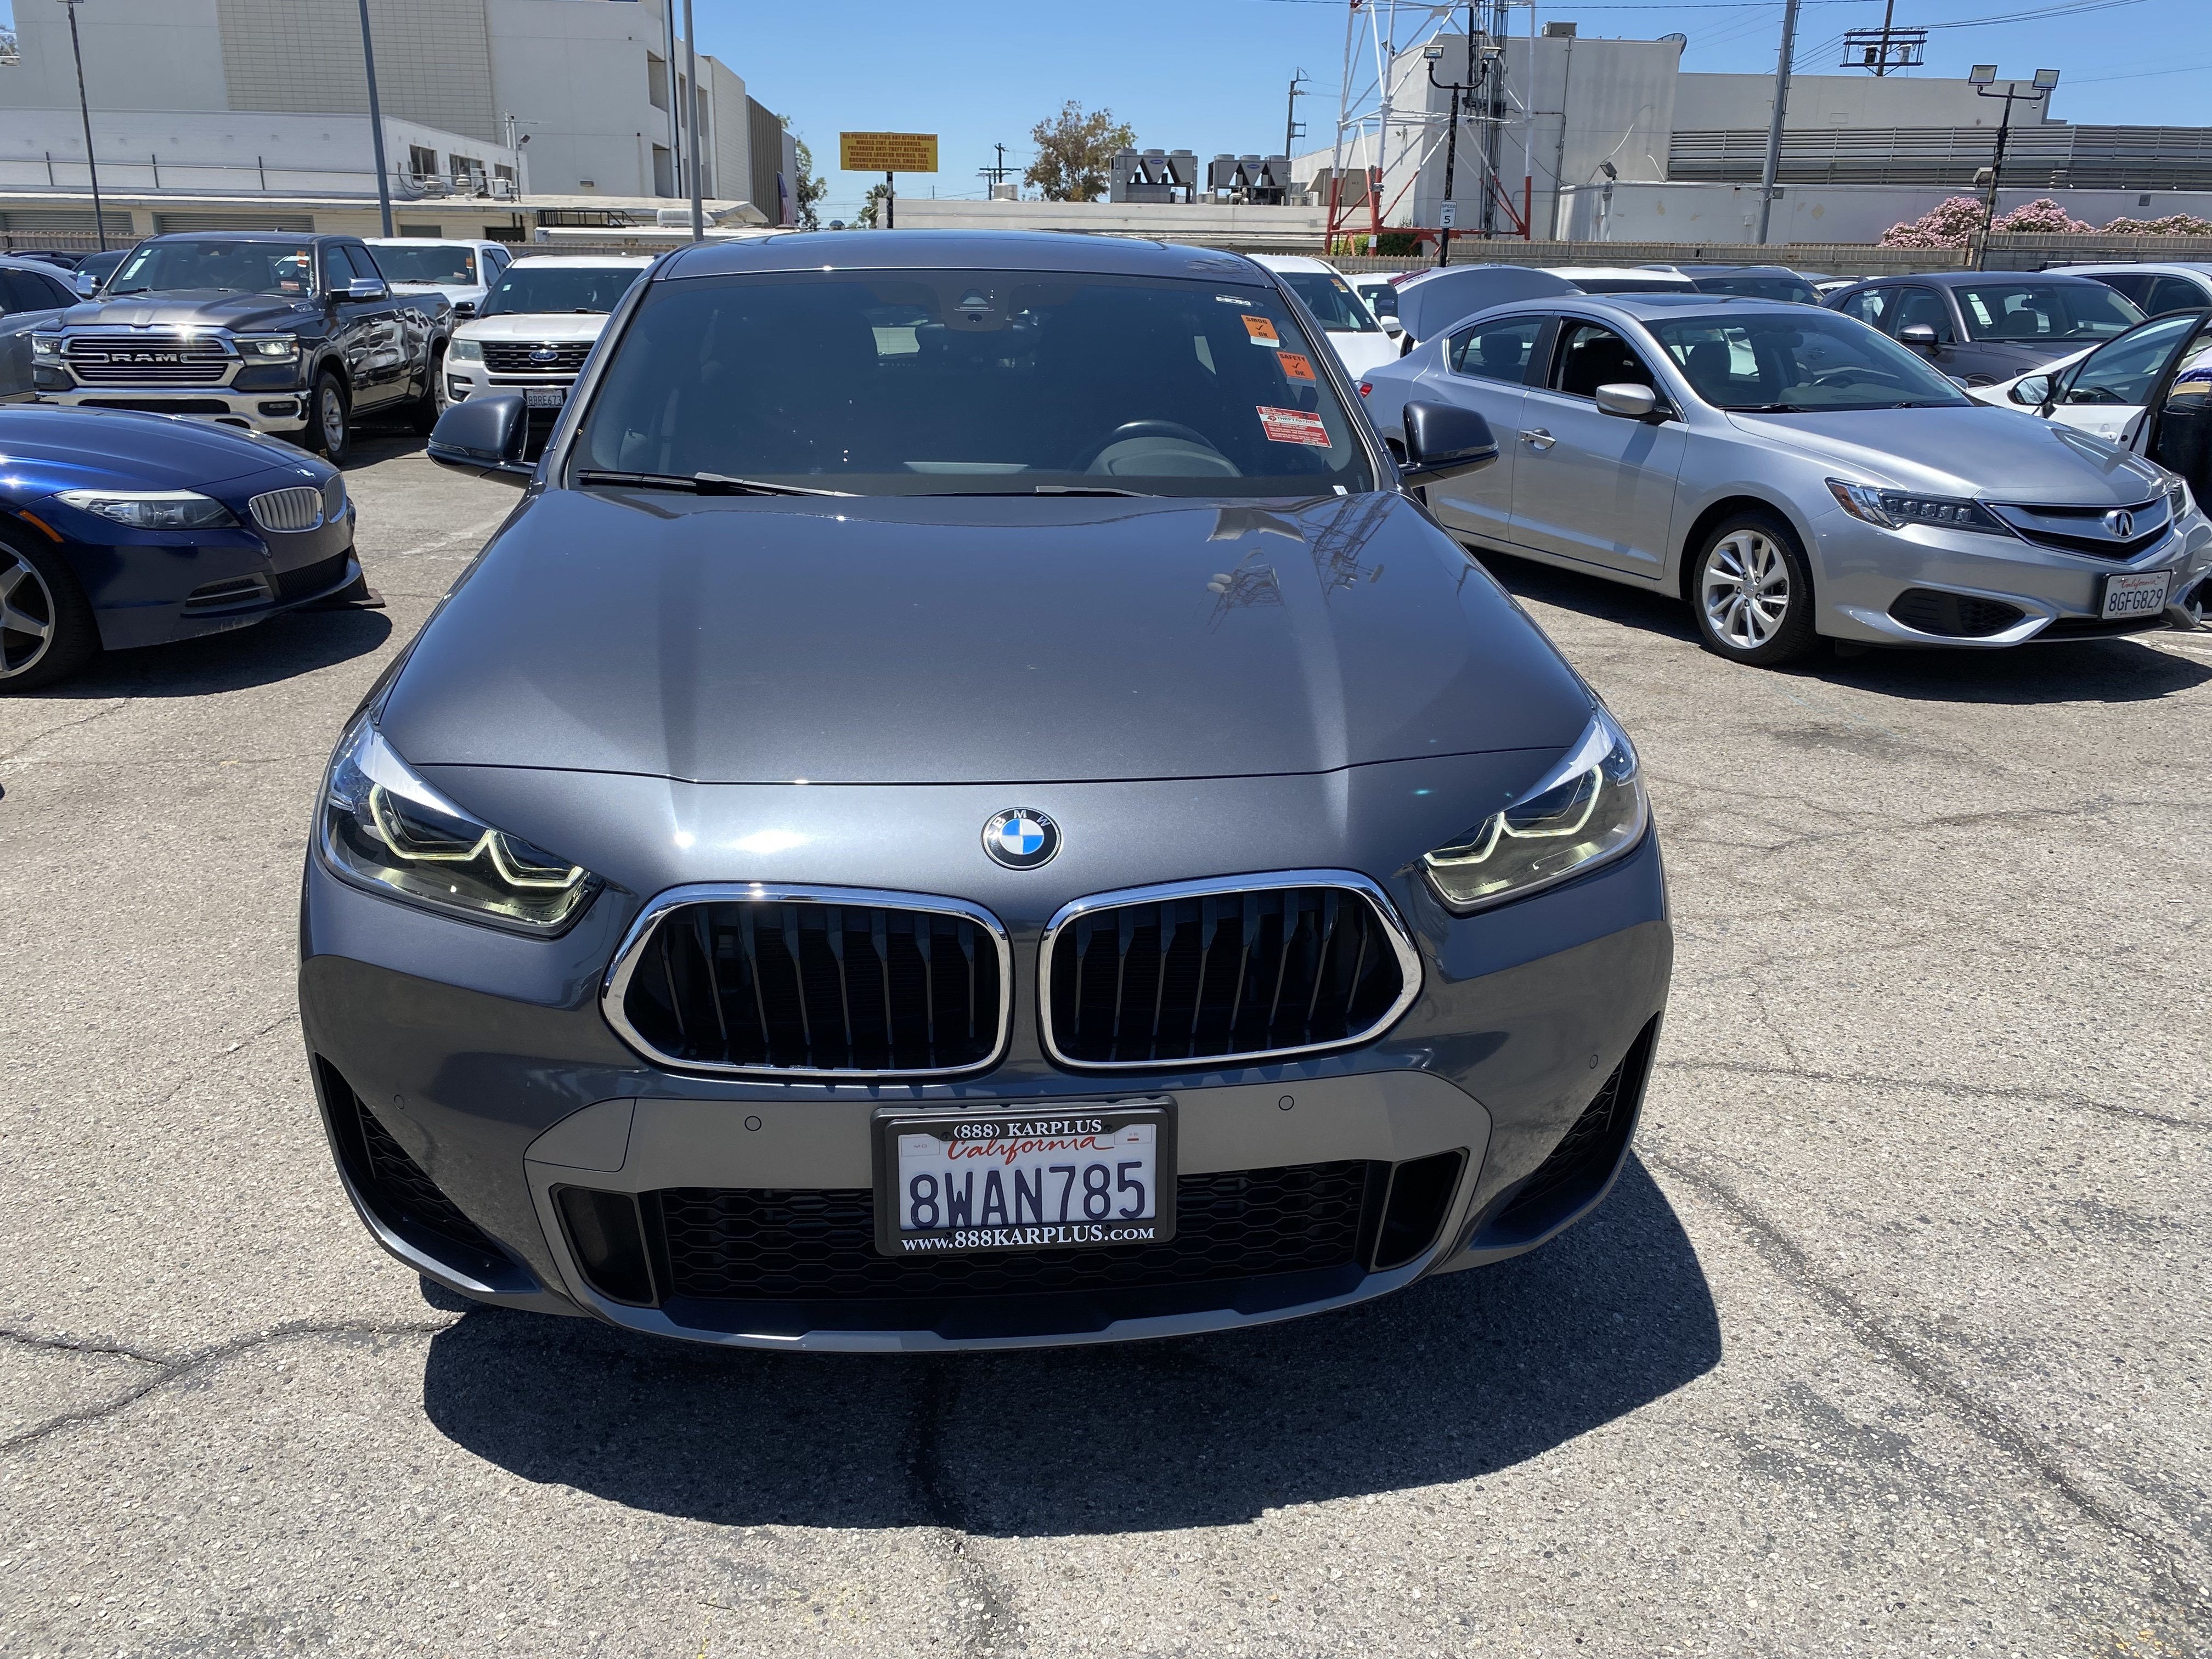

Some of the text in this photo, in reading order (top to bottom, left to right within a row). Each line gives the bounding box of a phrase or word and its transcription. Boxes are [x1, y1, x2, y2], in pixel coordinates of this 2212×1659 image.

[111, 353, 178, 362] RAM
[1279, 353, 1306, 362] SAFETY
[2121, 578, 2158, 590] California
[2109, 589, 2163, 612] 8GFG829
[993, 809, 1051, 829] BMW
[953, 1119, 1102, 1138] (888) KARPLUS
[947, 1135, 1115, 1165] California
[910, 1161, 1145, 1229] 8WAN785
